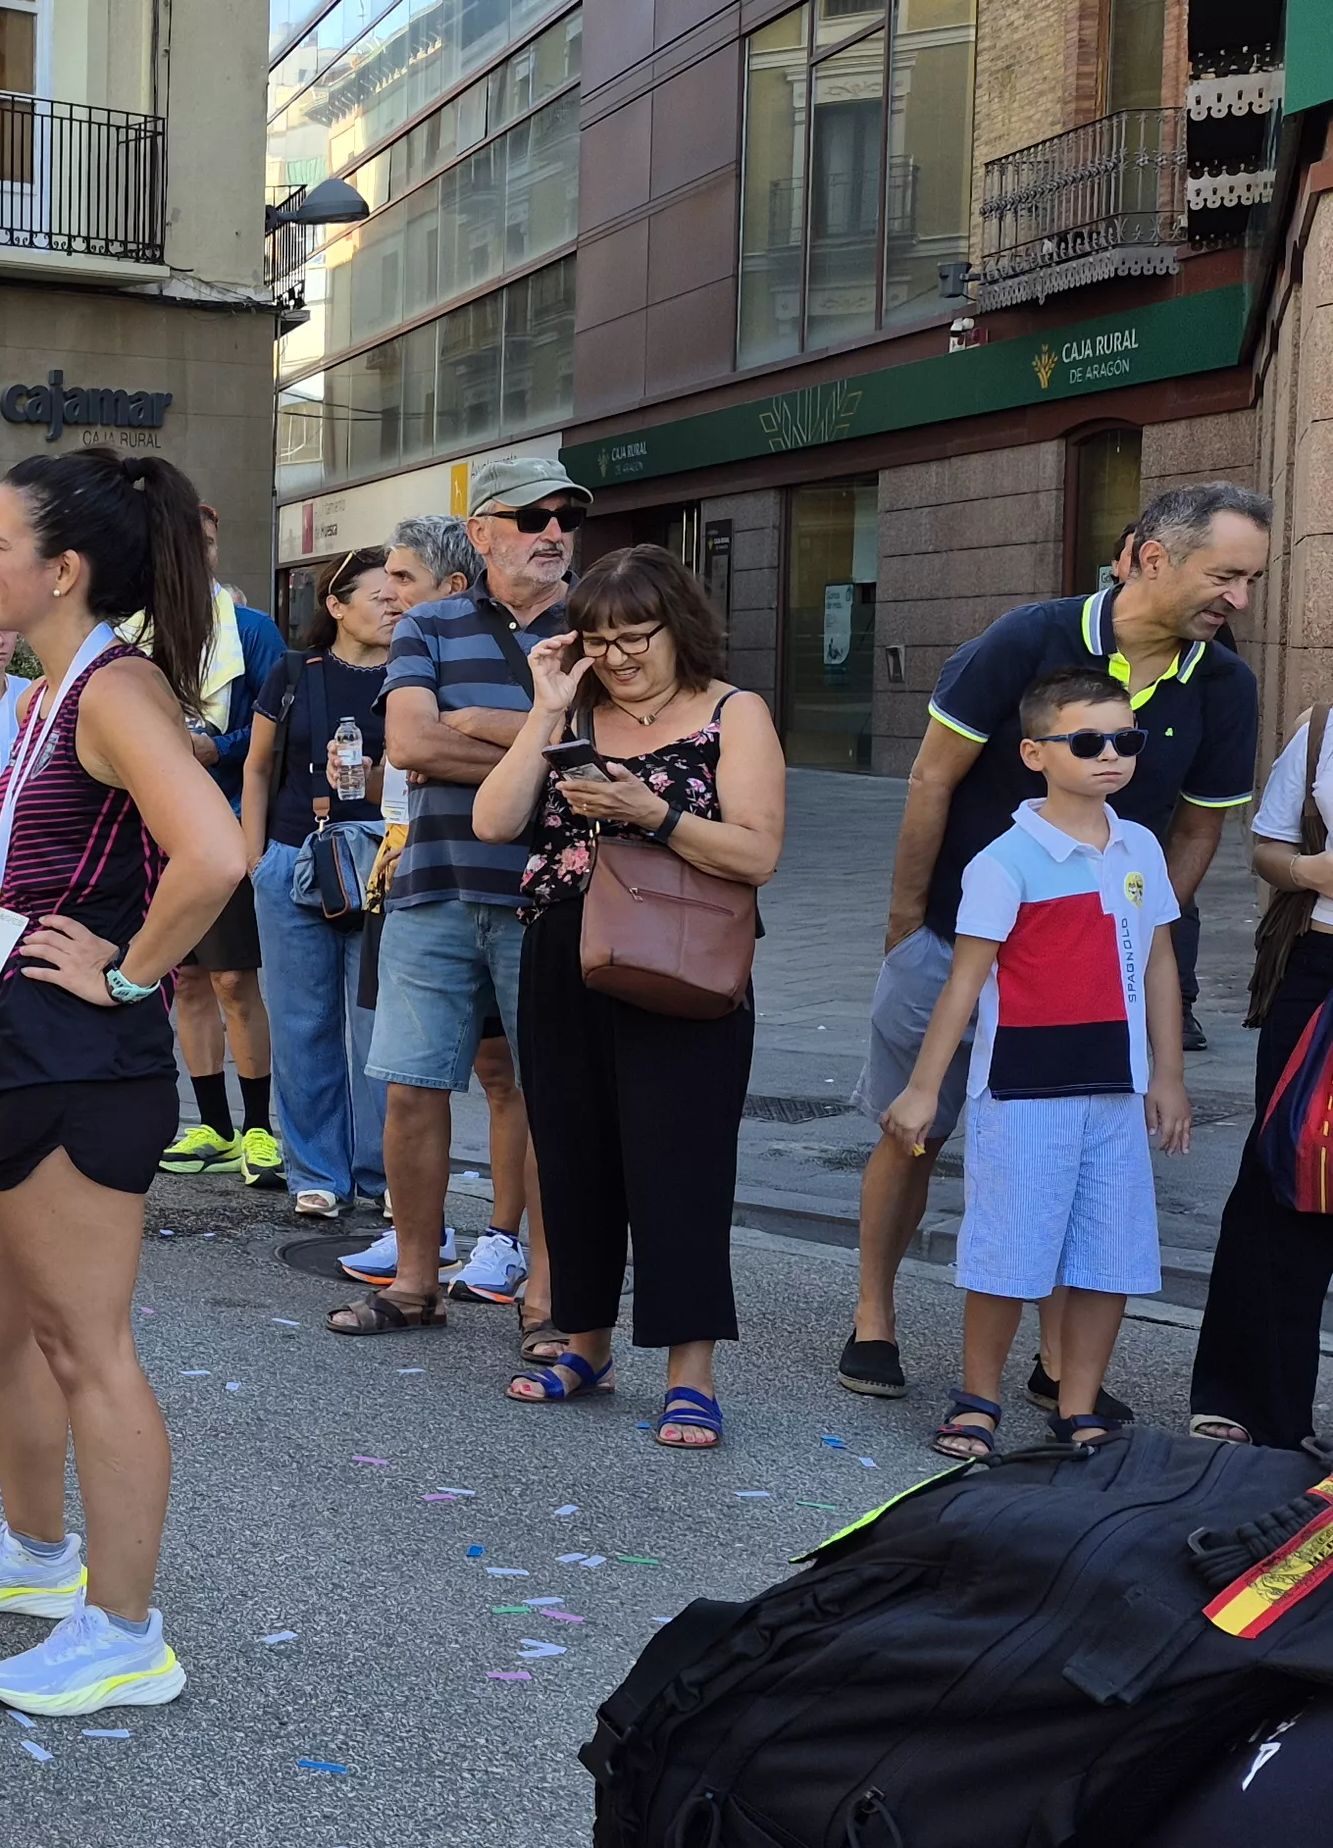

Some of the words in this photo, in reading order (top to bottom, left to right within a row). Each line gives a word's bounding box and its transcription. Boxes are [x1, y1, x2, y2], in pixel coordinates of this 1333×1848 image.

[1062, 338, 1093, 363] CAJA
[1096, 328, 1139, 356] RURAL
[1069, 367, 1083, 384] DE
[1085, 356, 1130, 380] ARAGÓN
[0, 370, 173, 442] cajamar
[120, 432, 162, 449] RURAL
[612, 447, 627, 461] CAJA
[627, 441, 648, 458] RURAL
[1122, 917, 1137, 1003] SPAGNOLO
